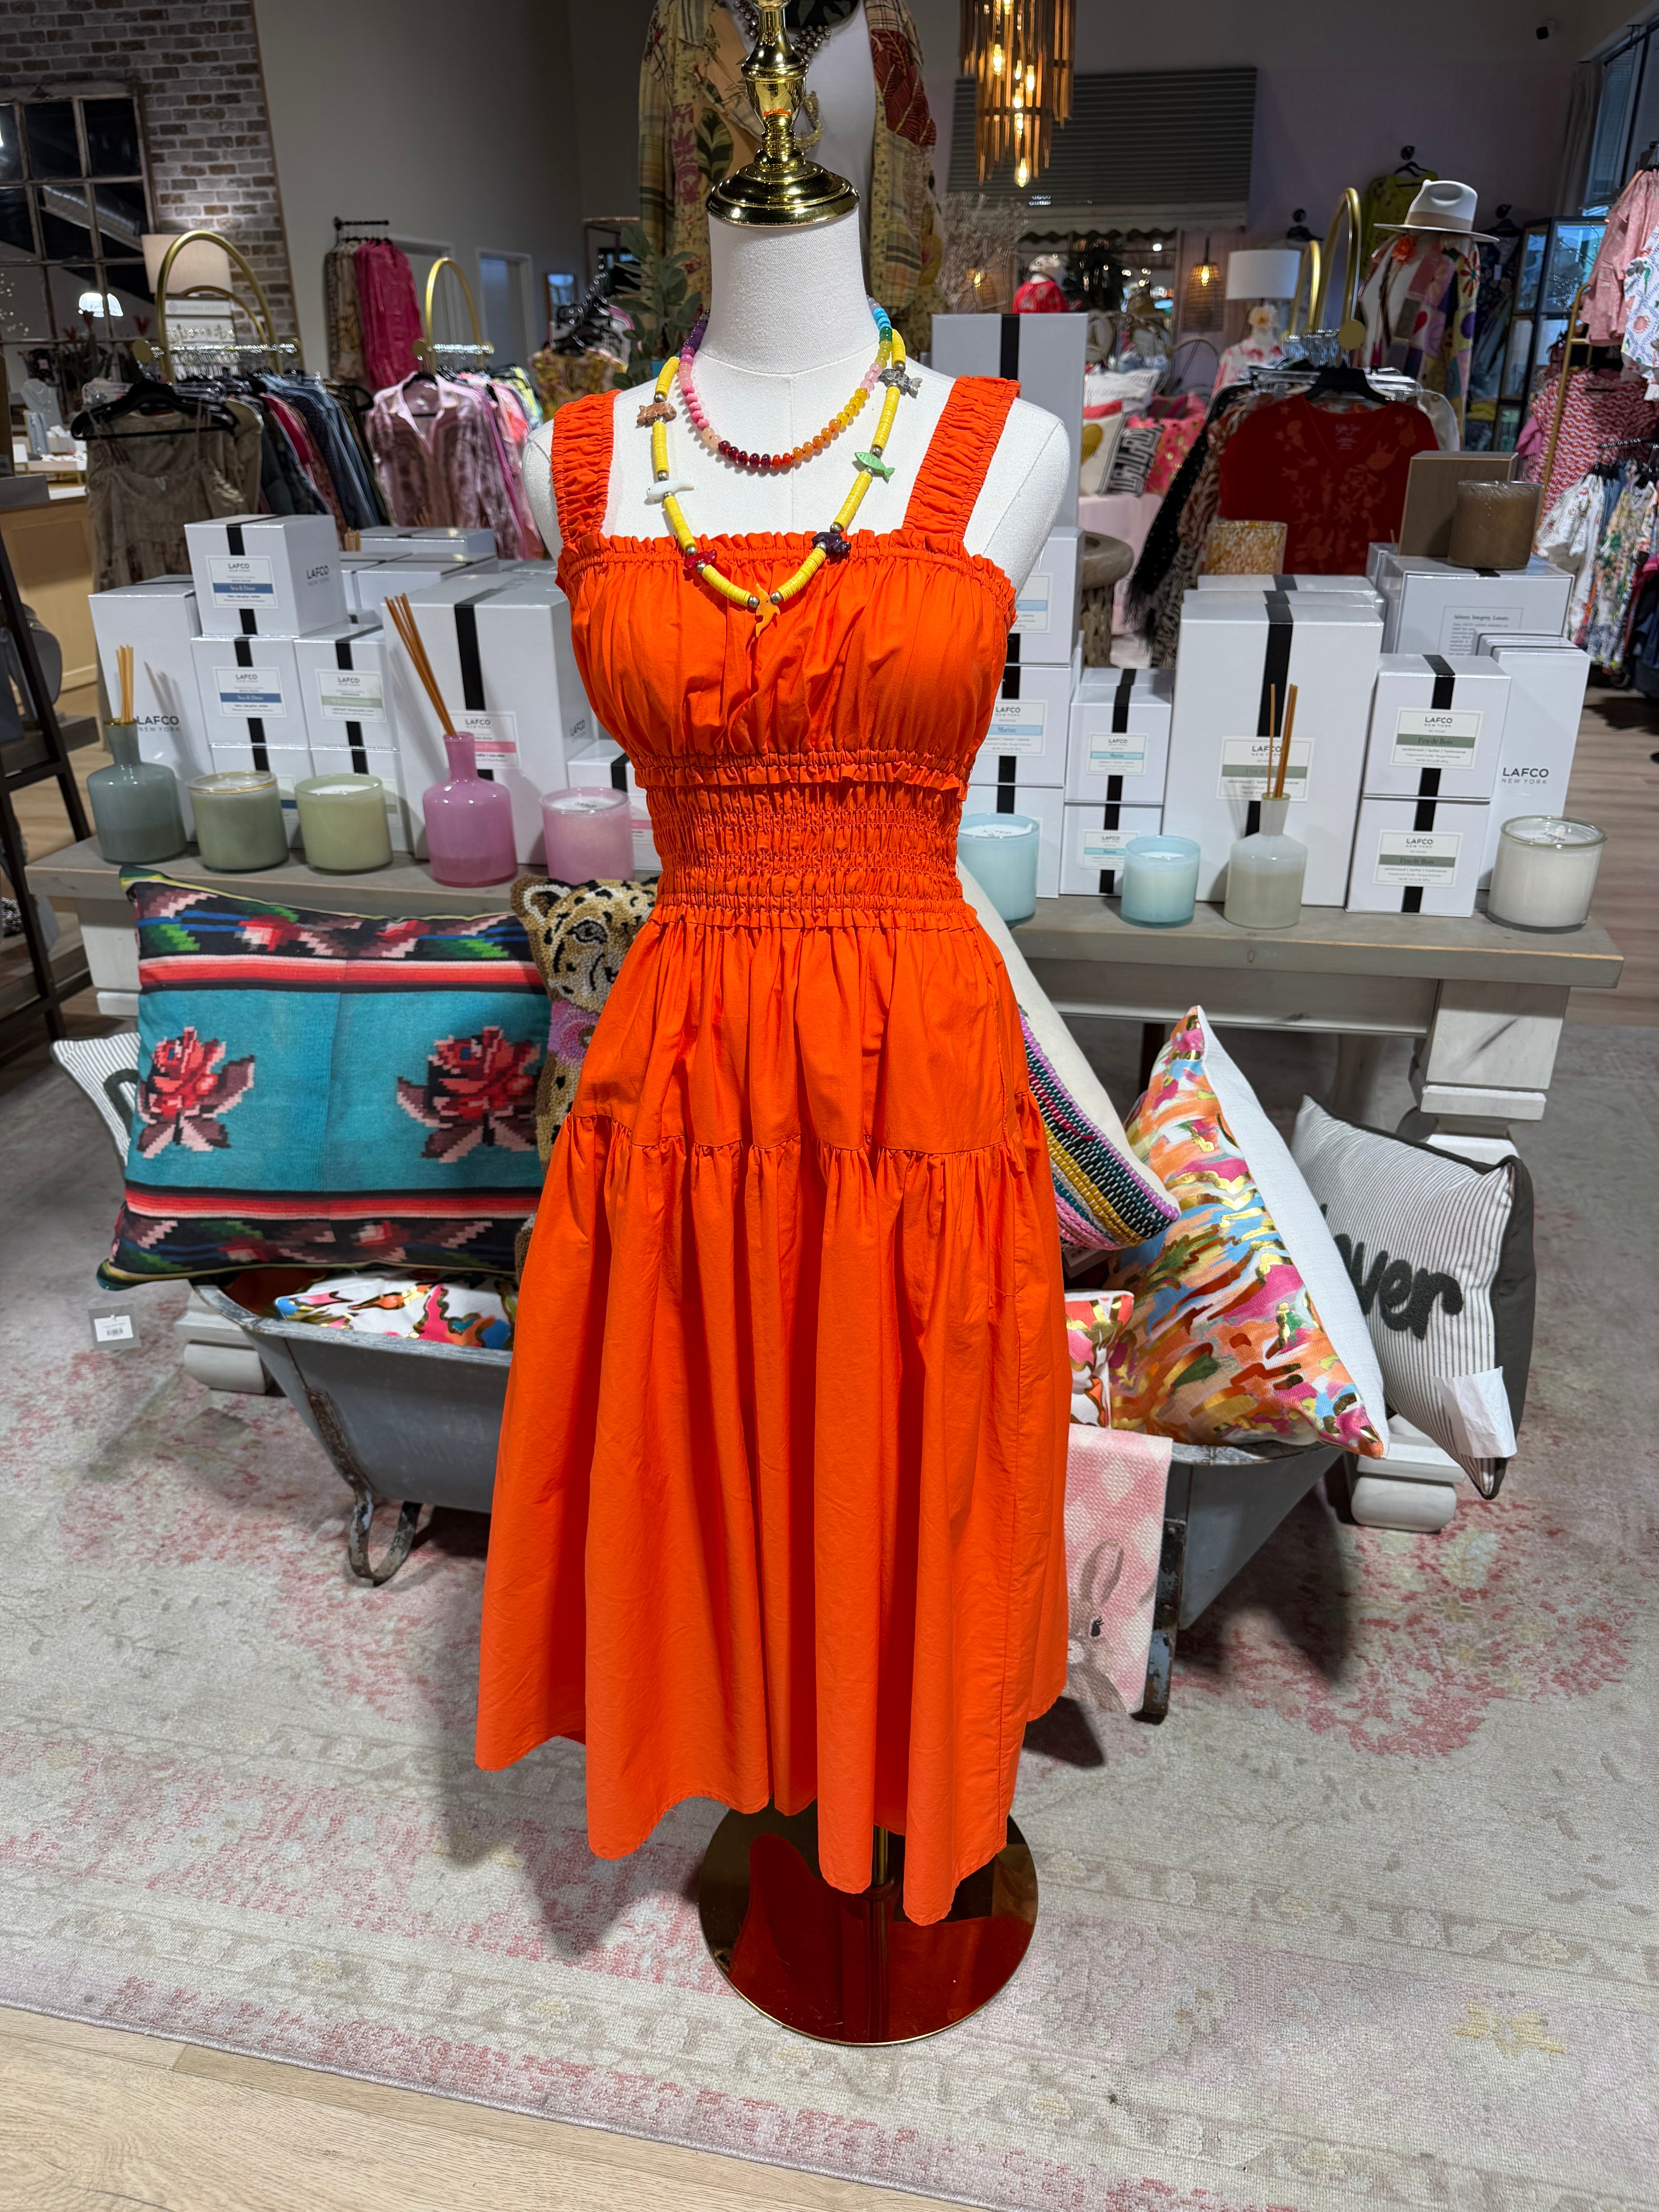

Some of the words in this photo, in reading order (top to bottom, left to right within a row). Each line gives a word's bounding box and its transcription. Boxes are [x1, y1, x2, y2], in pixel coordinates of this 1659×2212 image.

[306, 565, 329, 579] LAFCO
[136, 715, 179, 725] LAFCO
[1503, 767, 1549, 778] LAFCO
